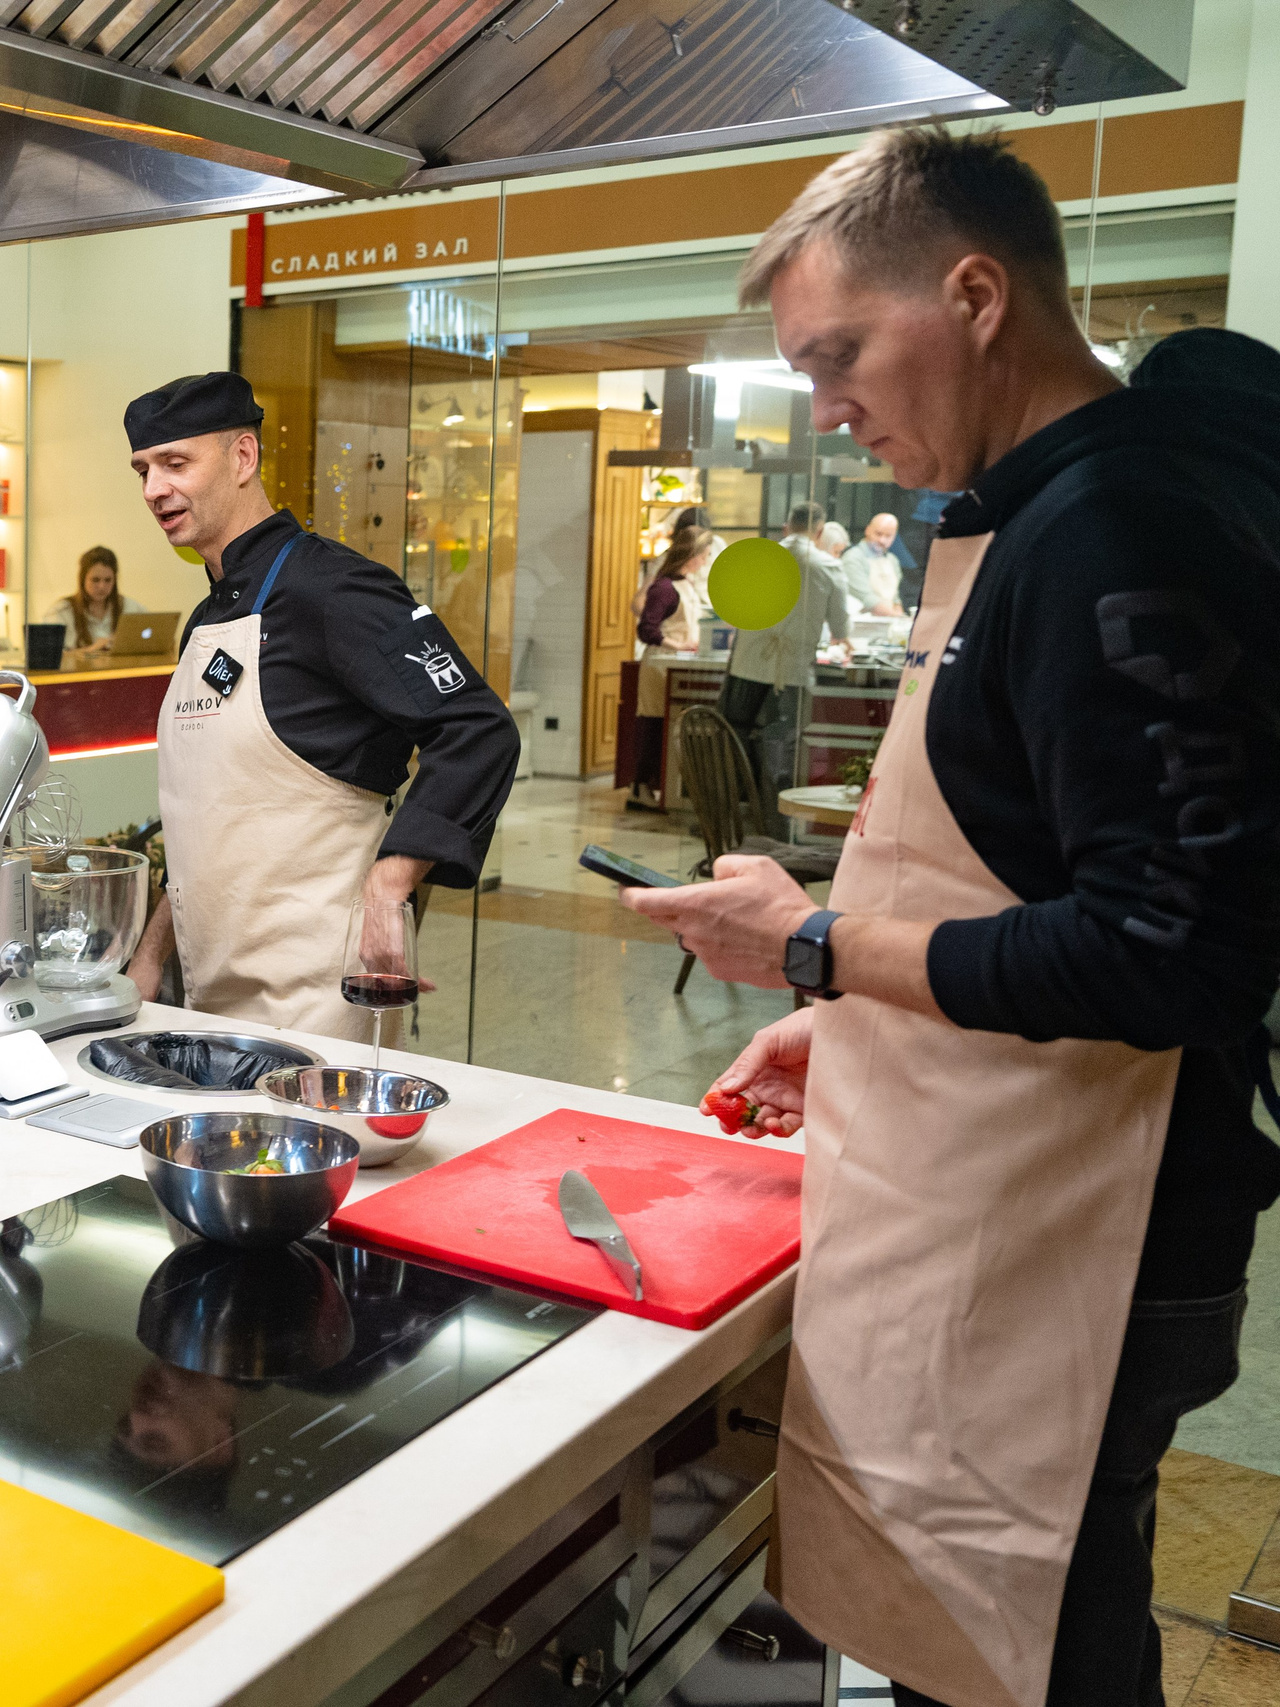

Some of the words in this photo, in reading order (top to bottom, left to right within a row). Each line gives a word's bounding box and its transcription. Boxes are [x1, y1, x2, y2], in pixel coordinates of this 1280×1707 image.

[271, 242, 398, 275] СЛАДКИЙ
[414, 236, 469, 260] ЗАЛ
[208, 655, 233, 682] Олег
[175, 697, 223, 713] NOVIKOV
